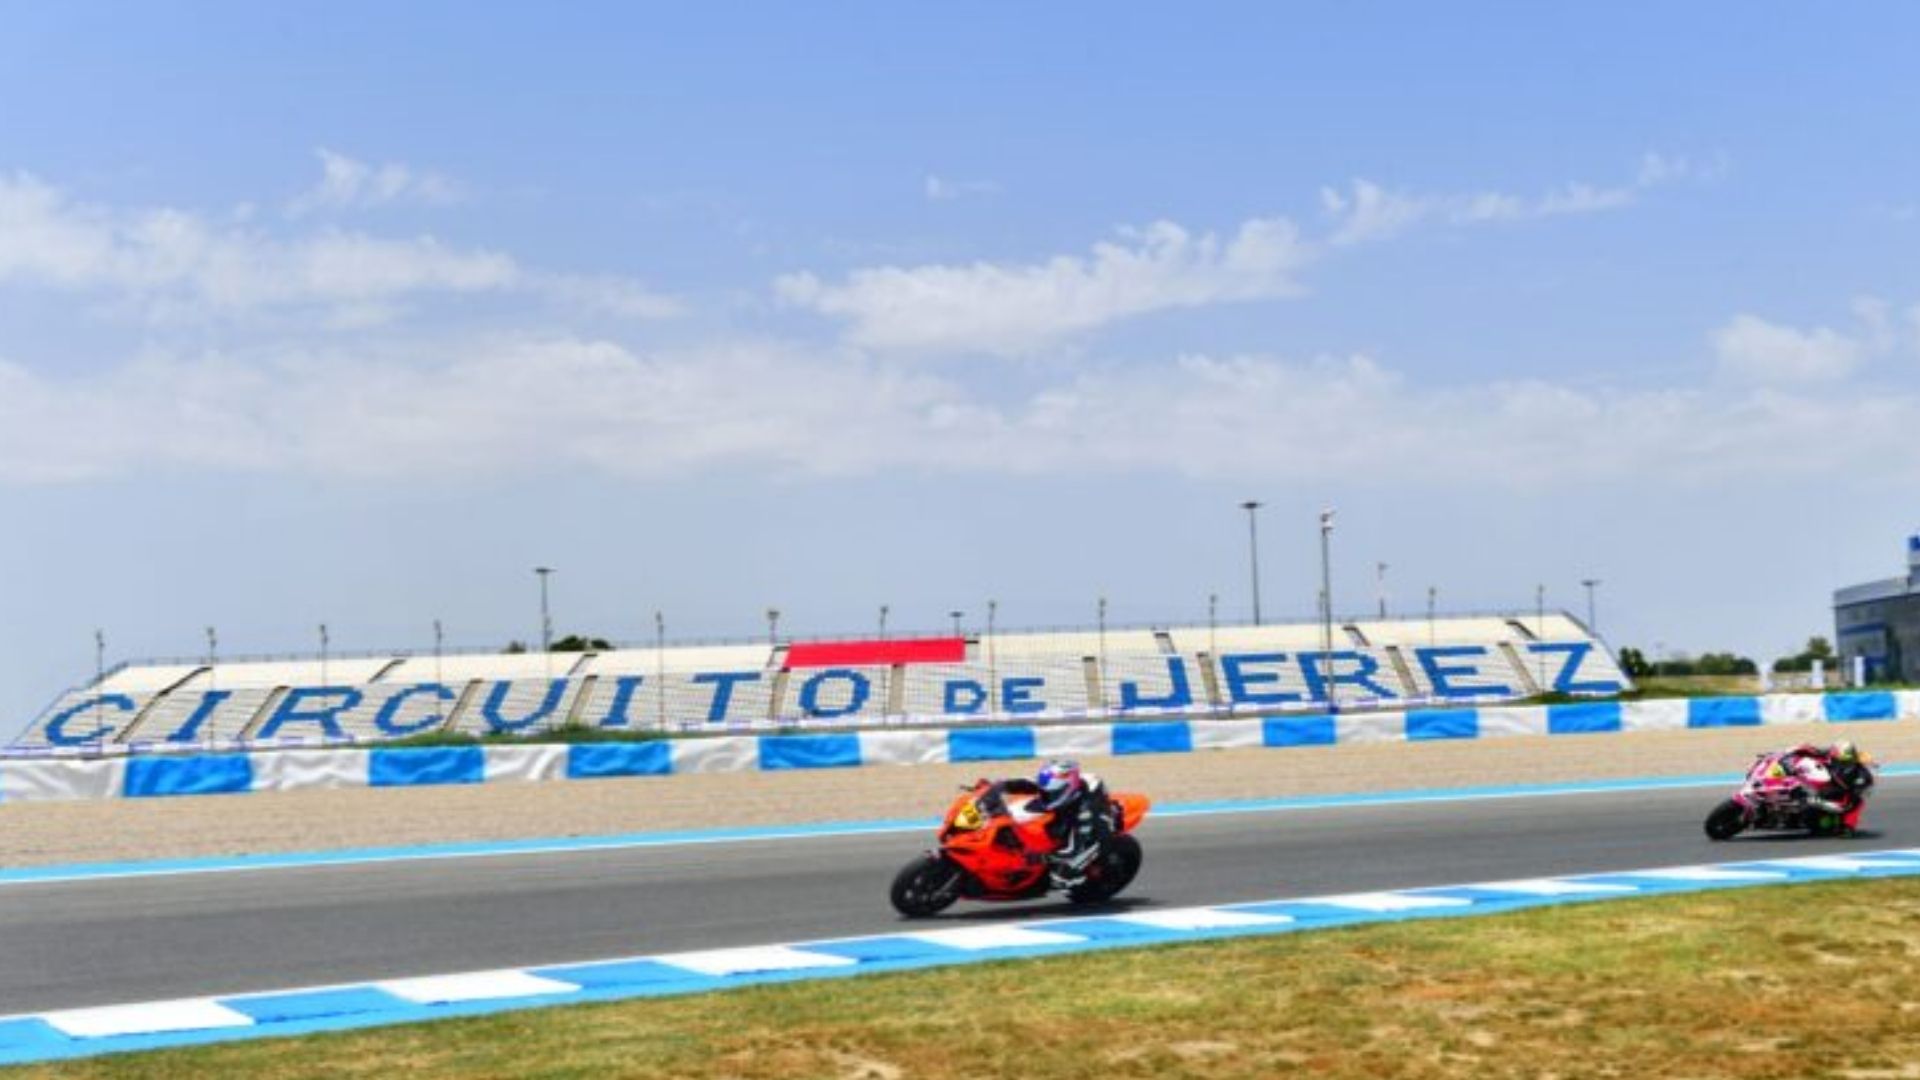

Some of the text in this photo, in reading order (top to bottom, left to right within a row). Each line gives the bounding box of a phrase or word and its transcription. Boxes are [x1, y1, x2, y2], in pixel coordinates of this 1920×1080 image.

[44, 642, 1623, 746] CIRCUITO DE JEREZ
